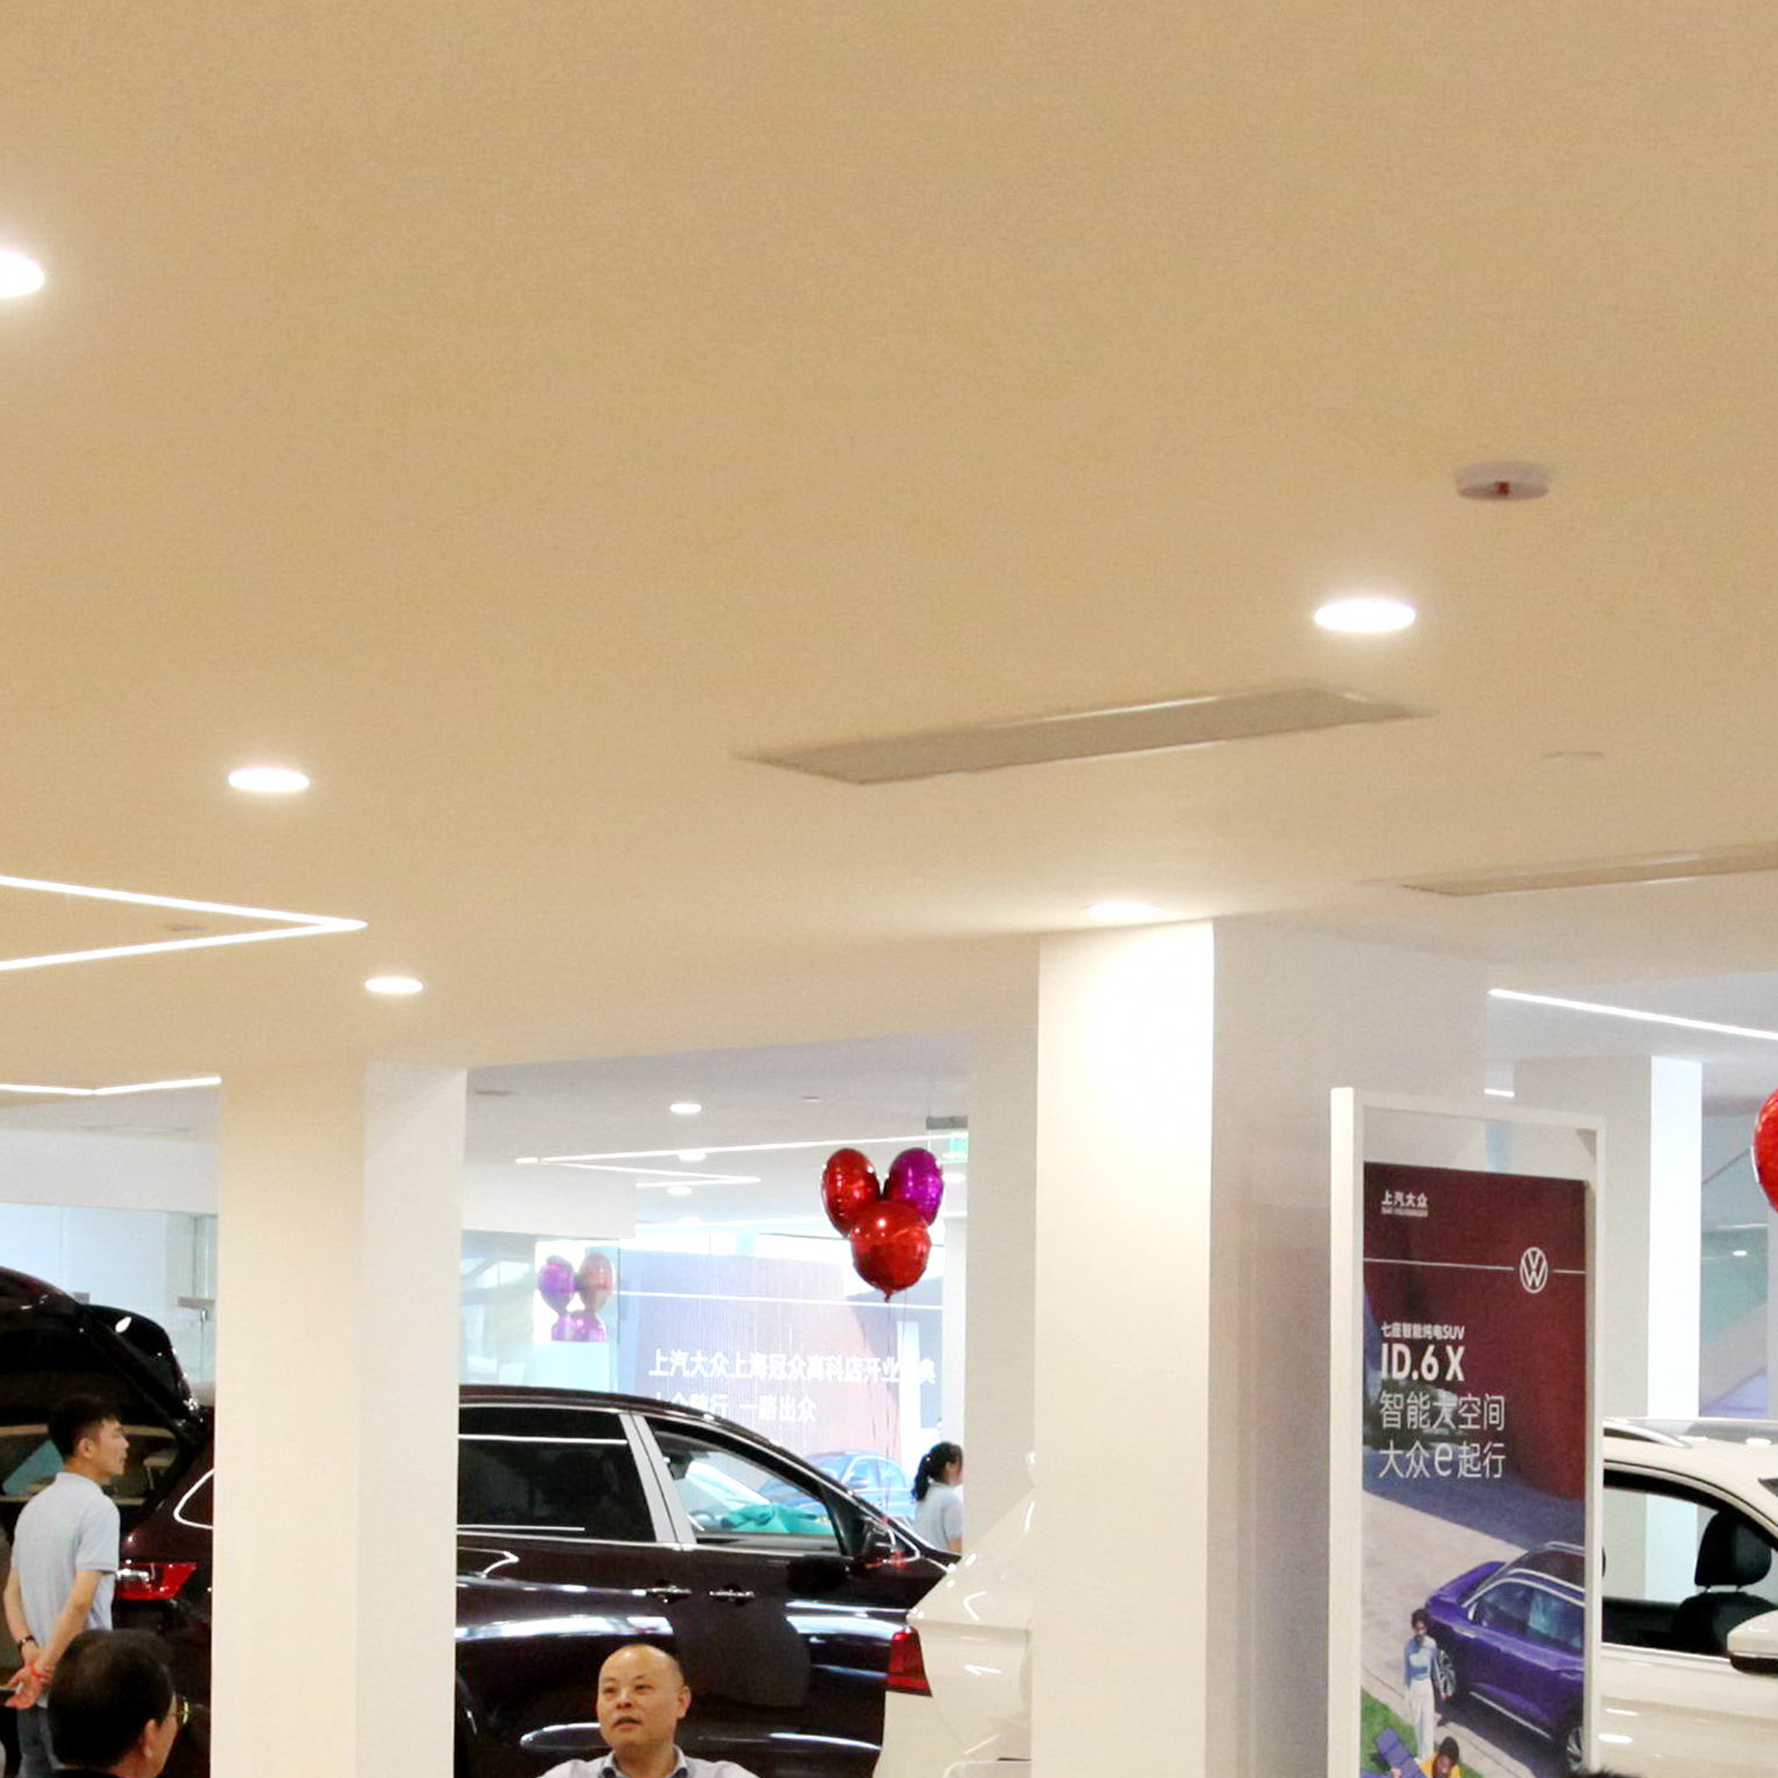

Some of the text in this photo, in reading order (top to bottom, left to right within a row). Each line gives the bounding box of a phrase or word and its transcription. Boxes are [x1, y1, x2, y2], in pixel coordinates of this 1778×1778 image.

[1381, 1190, 1428, 1208] 上汽大众
[648, 1349, 937, 1385] 上汽大众上海冠众高科店开业典
[1381, 1343, 1466, 1382] ID.6 X
[1379, 1390, 1505, 1432] 智能大空间
[1378, 1438, 1507, 1479] 大众e起行
